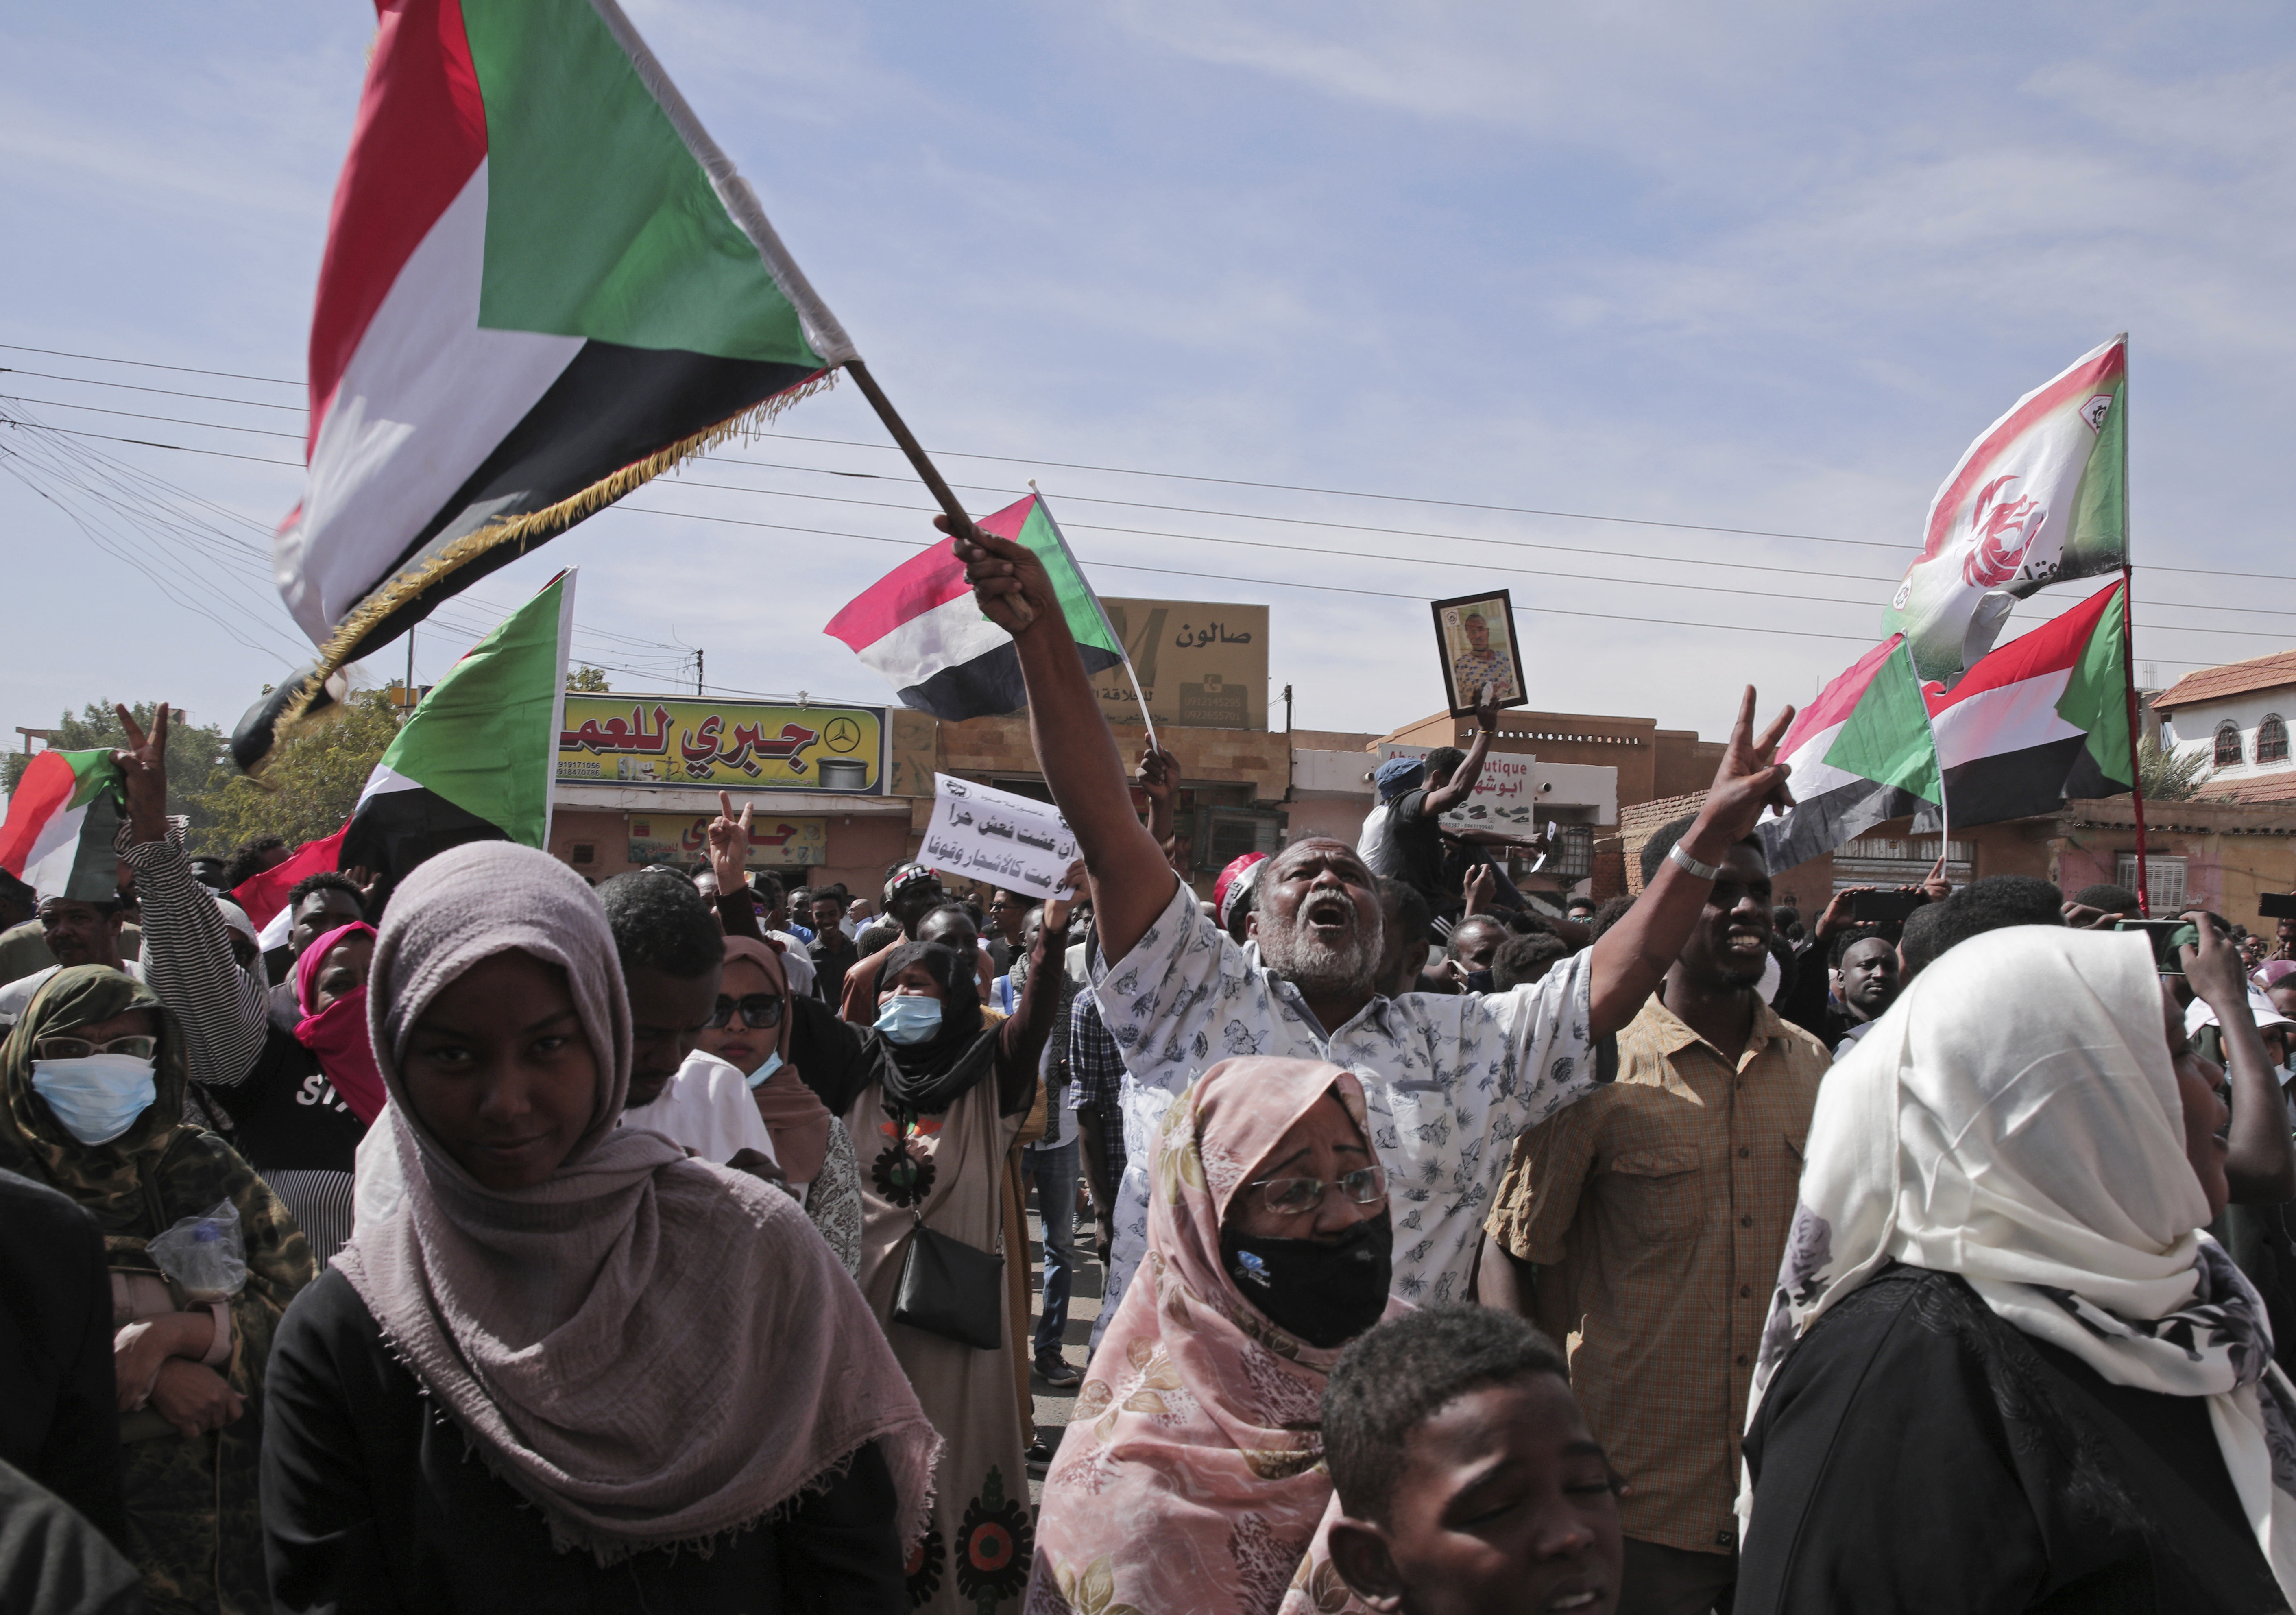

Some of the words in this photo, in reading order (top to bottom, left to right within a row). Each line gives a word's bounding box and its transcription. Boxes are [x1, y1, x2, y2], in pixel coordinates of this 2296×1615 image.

[1176, 622, 1252, 648] صالون
[559, 704, 674, 755] للعم
[680, 714, 820, 779] جبري
[557, 761, 601, 769] 919171056
[1484, 759, 1527, 777] utique
[948, 803, 974, 827] حرا
[978, 815, 1014, 839] فعش
[682, 818, 798, 860] جبي
[927, 834, 964, 865] وقوفا
[1024, 868, 1052, 888] مت
[296, 1074, 349, 1113] ST
